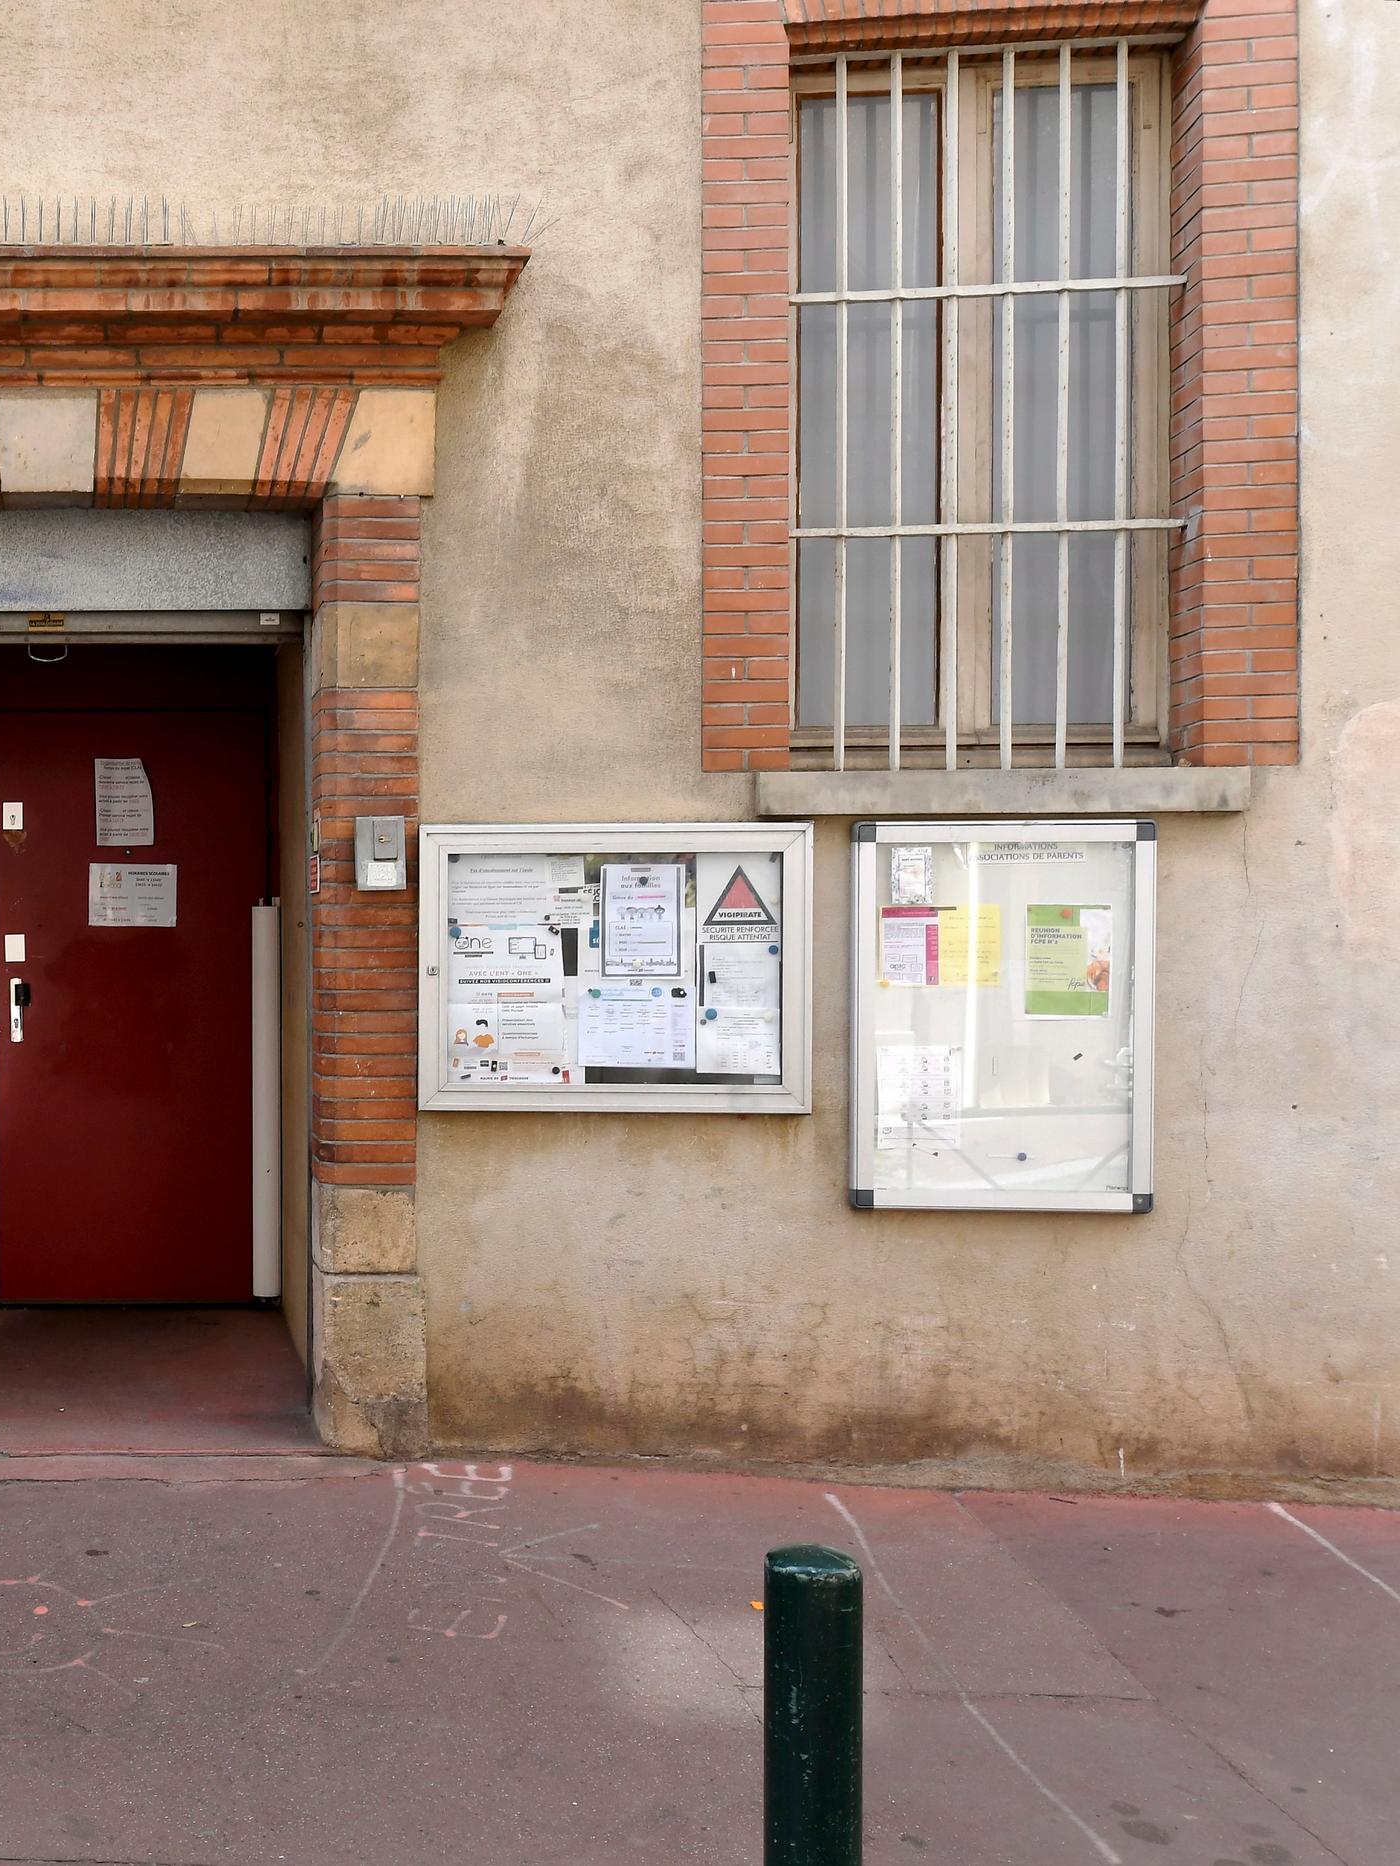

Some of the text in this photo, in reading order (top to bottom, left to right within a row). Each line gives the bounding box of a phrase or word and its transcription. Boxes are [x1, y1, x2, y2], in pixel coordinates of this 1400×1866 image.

[1047, 852, 1084, 860] PARENTS
[718, 911, 762, 919] VIGIPIRATE
[737, 933, 772, 941] ATTENTAT
